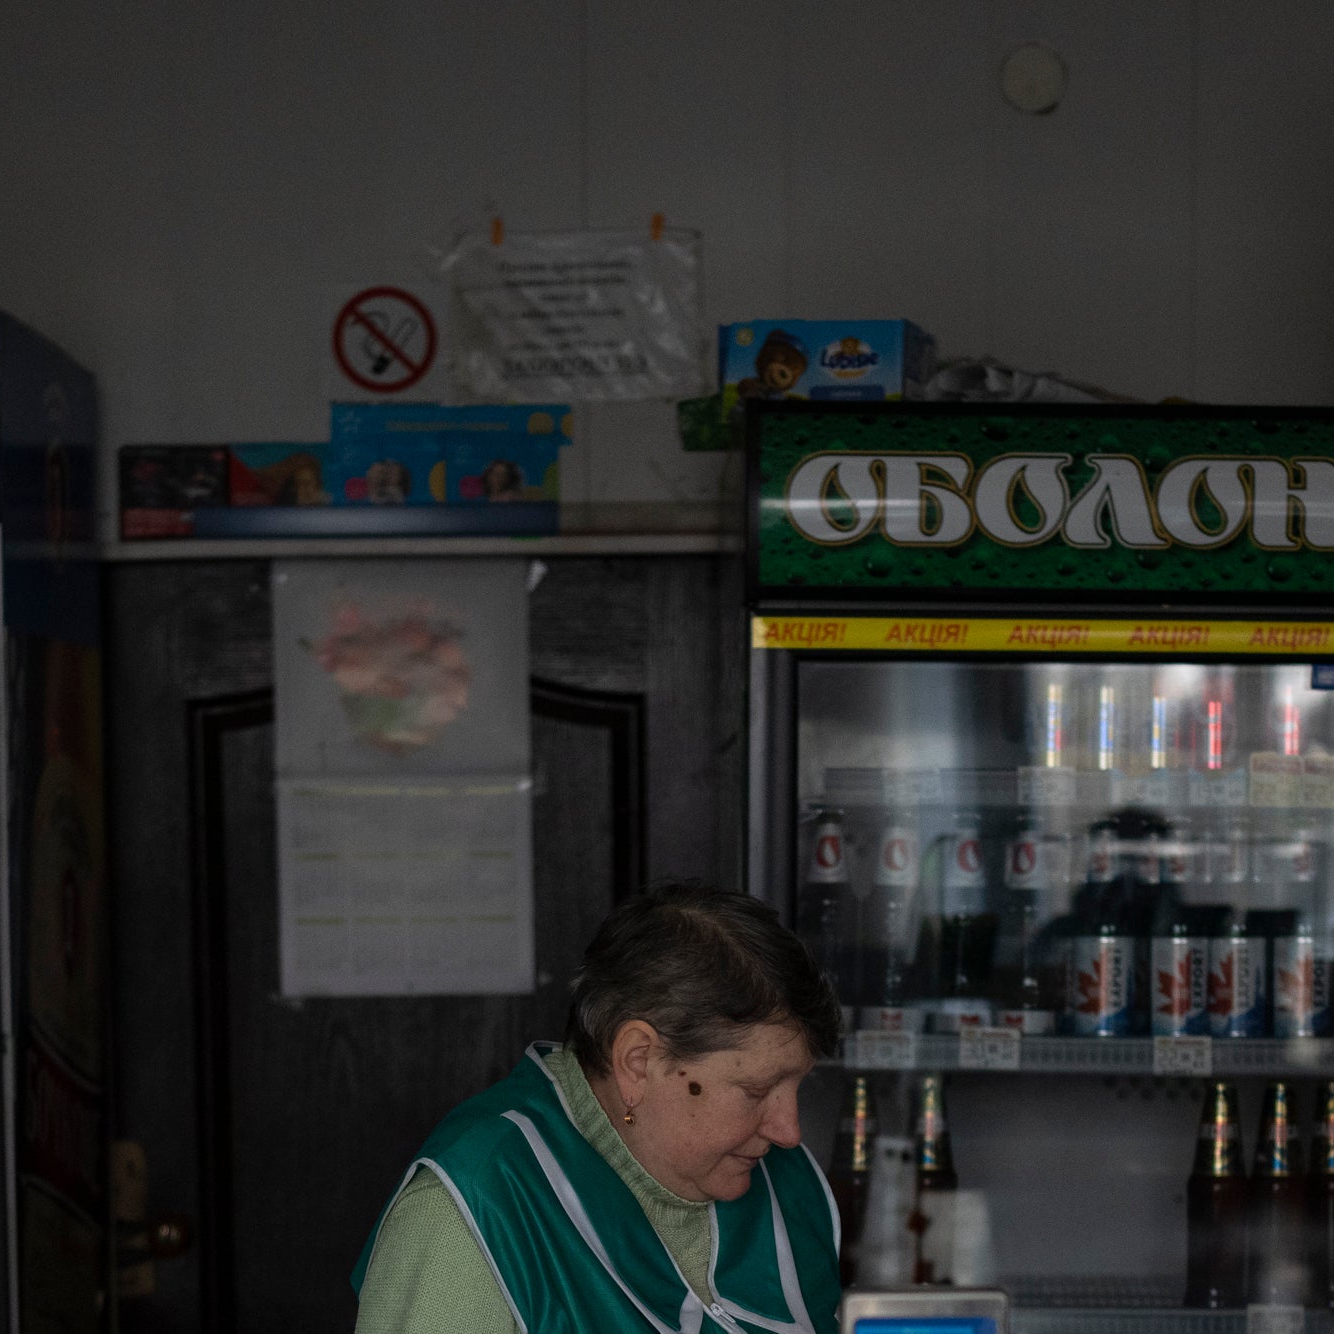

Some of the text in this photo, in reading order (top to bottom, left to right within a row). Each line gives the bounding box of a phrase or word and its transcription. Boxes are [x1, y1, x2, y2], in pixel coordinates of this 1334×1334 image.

[763, 622, 847, 645] АКЦІЯ!
[885, 623, 969, 645] АКЦІЯ!
[1008, 624, 1092, 647] АКЦІЯ!
[1128, 625, 1212, 648] АКЦІЯ!
[1248, 626, 1332, 649] АКЦІЯ!
